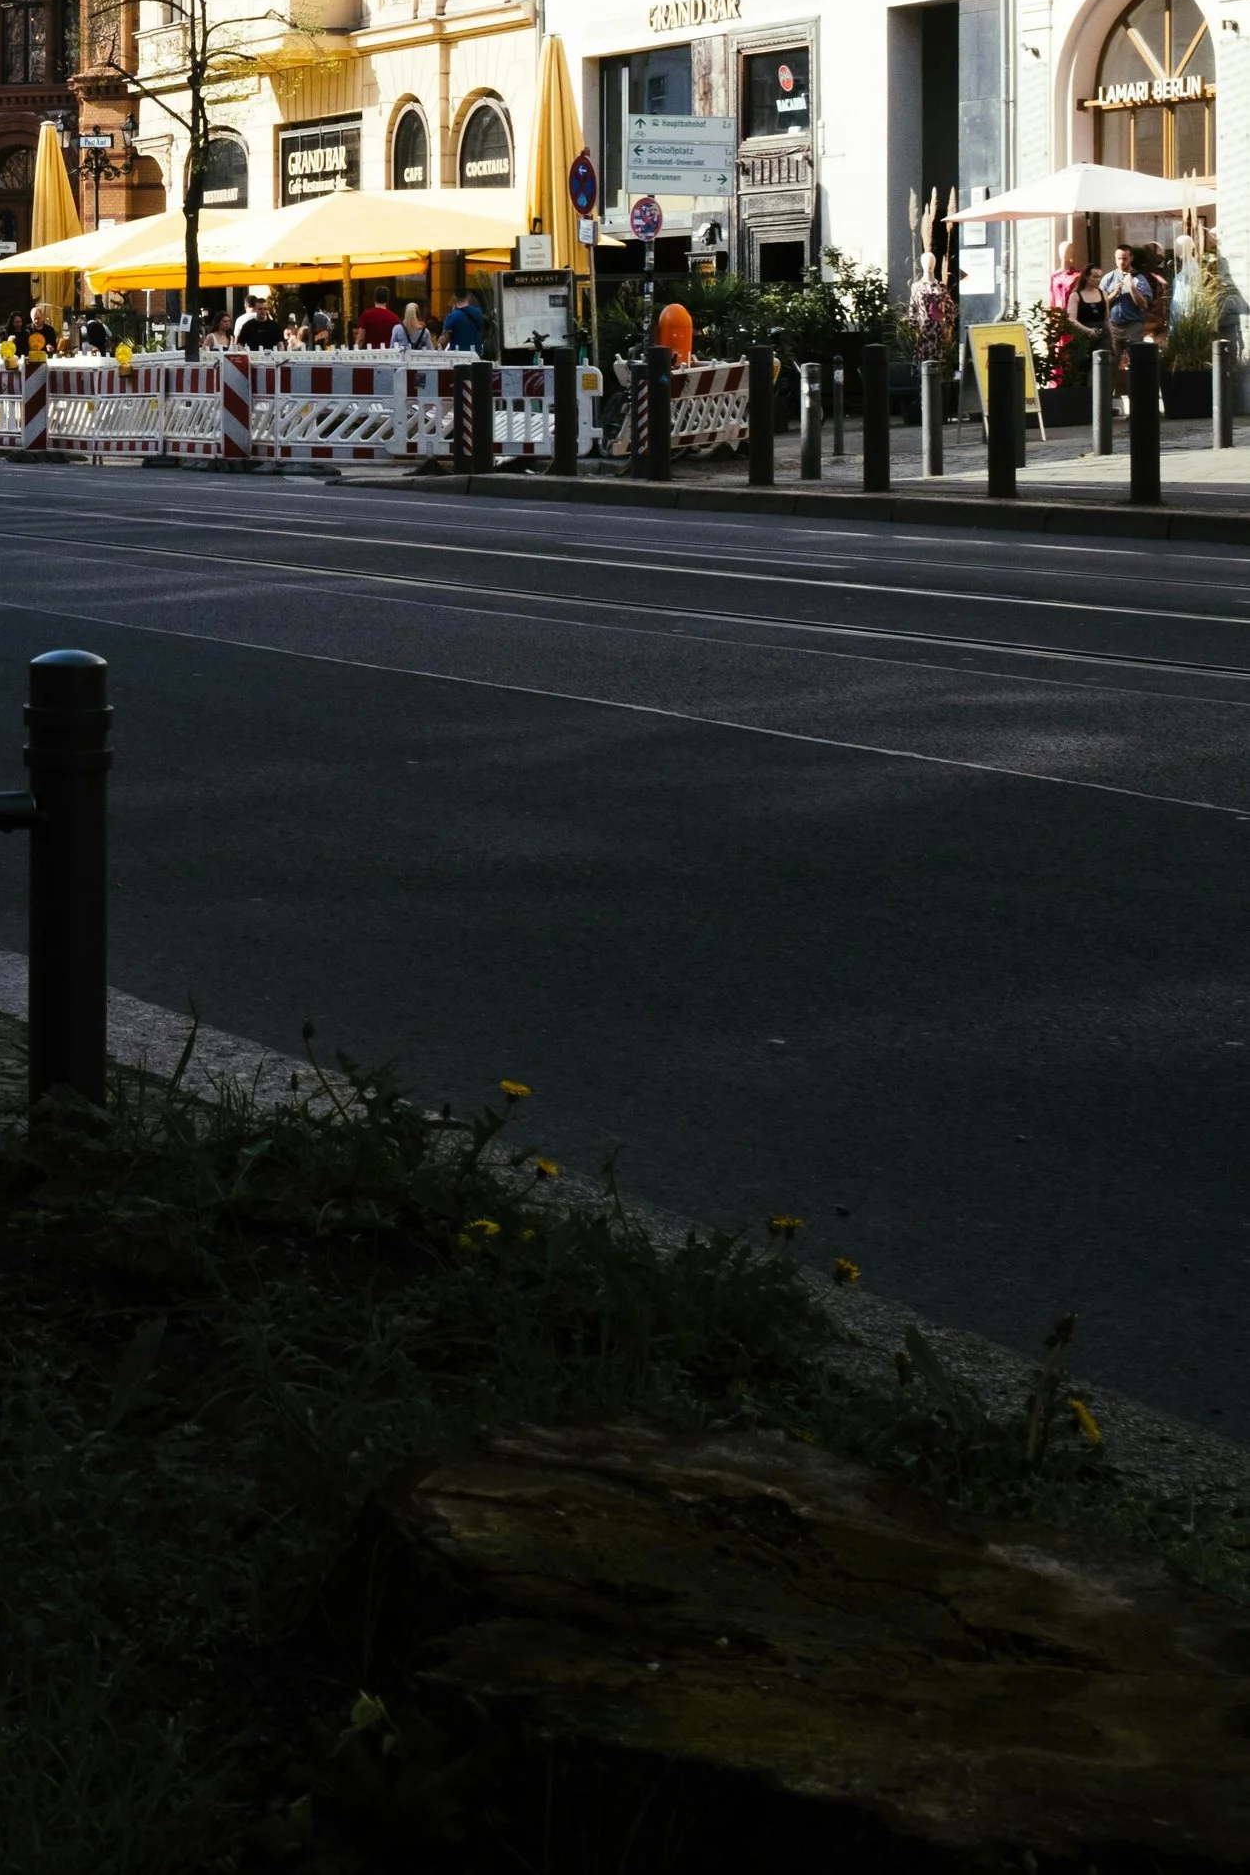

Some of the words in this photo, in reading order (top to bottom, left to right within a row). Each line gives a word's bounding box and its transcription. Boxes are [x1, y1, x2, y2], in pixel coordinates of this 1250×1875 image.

[649, 0, 705, 33] GRAND
[1098, 81, 1149, 105] LAMARI
[1153, 75, 1202, 100] BERLIN
[648, 145, 694, 155] Schloßplatz
[288, 148, 324, 176] GRAND
[325, 145, 347, 172] BAR
[465, 158, 510, 178] COCKTAILS
[403, 166, 424, 183] CAFE
[631, 172, 682, 181] Gesundbrunnen
[515, 276, 559, 285] BREAKFAST
